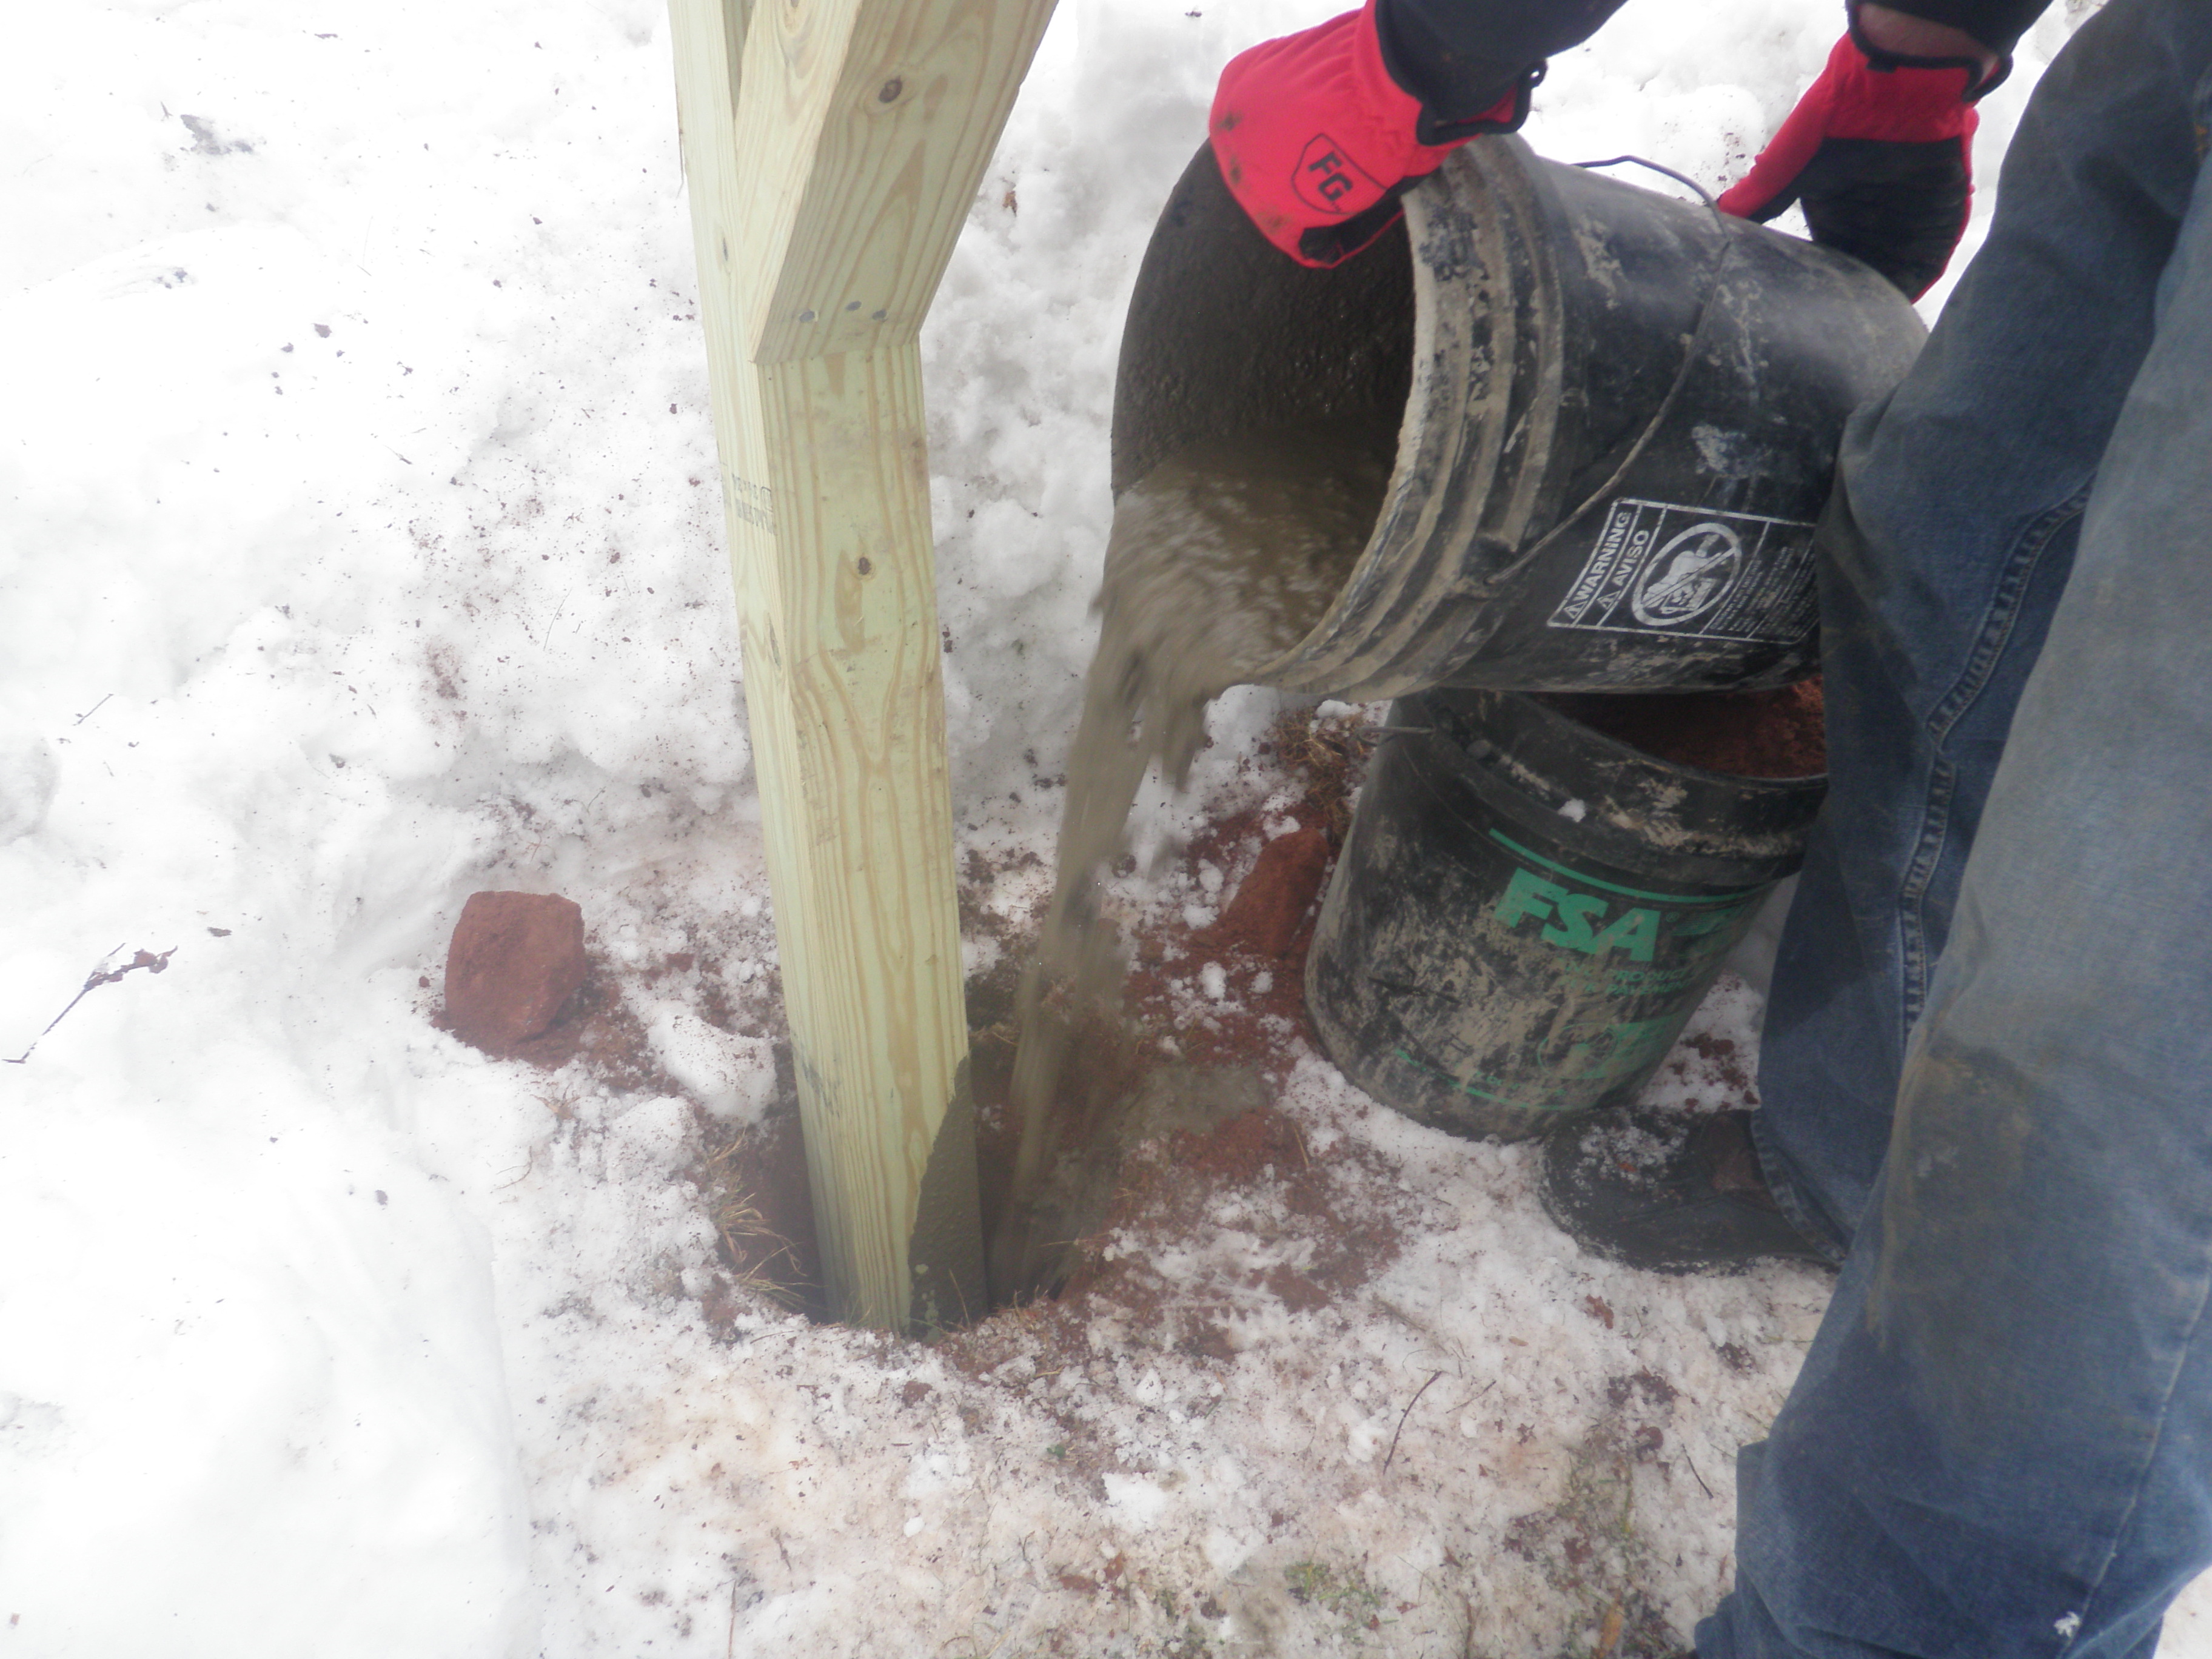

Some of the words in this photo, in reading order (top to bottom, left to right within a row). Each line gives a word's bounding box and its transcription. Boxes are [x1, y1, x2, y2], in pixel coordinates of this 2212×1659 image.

[1308, 152, 1353, 201] FG
[1573, 512, 1632, 601] WARNING
[1612, 530, 1649, 586] AVISO
[1495, 867, 1661, 962] FSA
